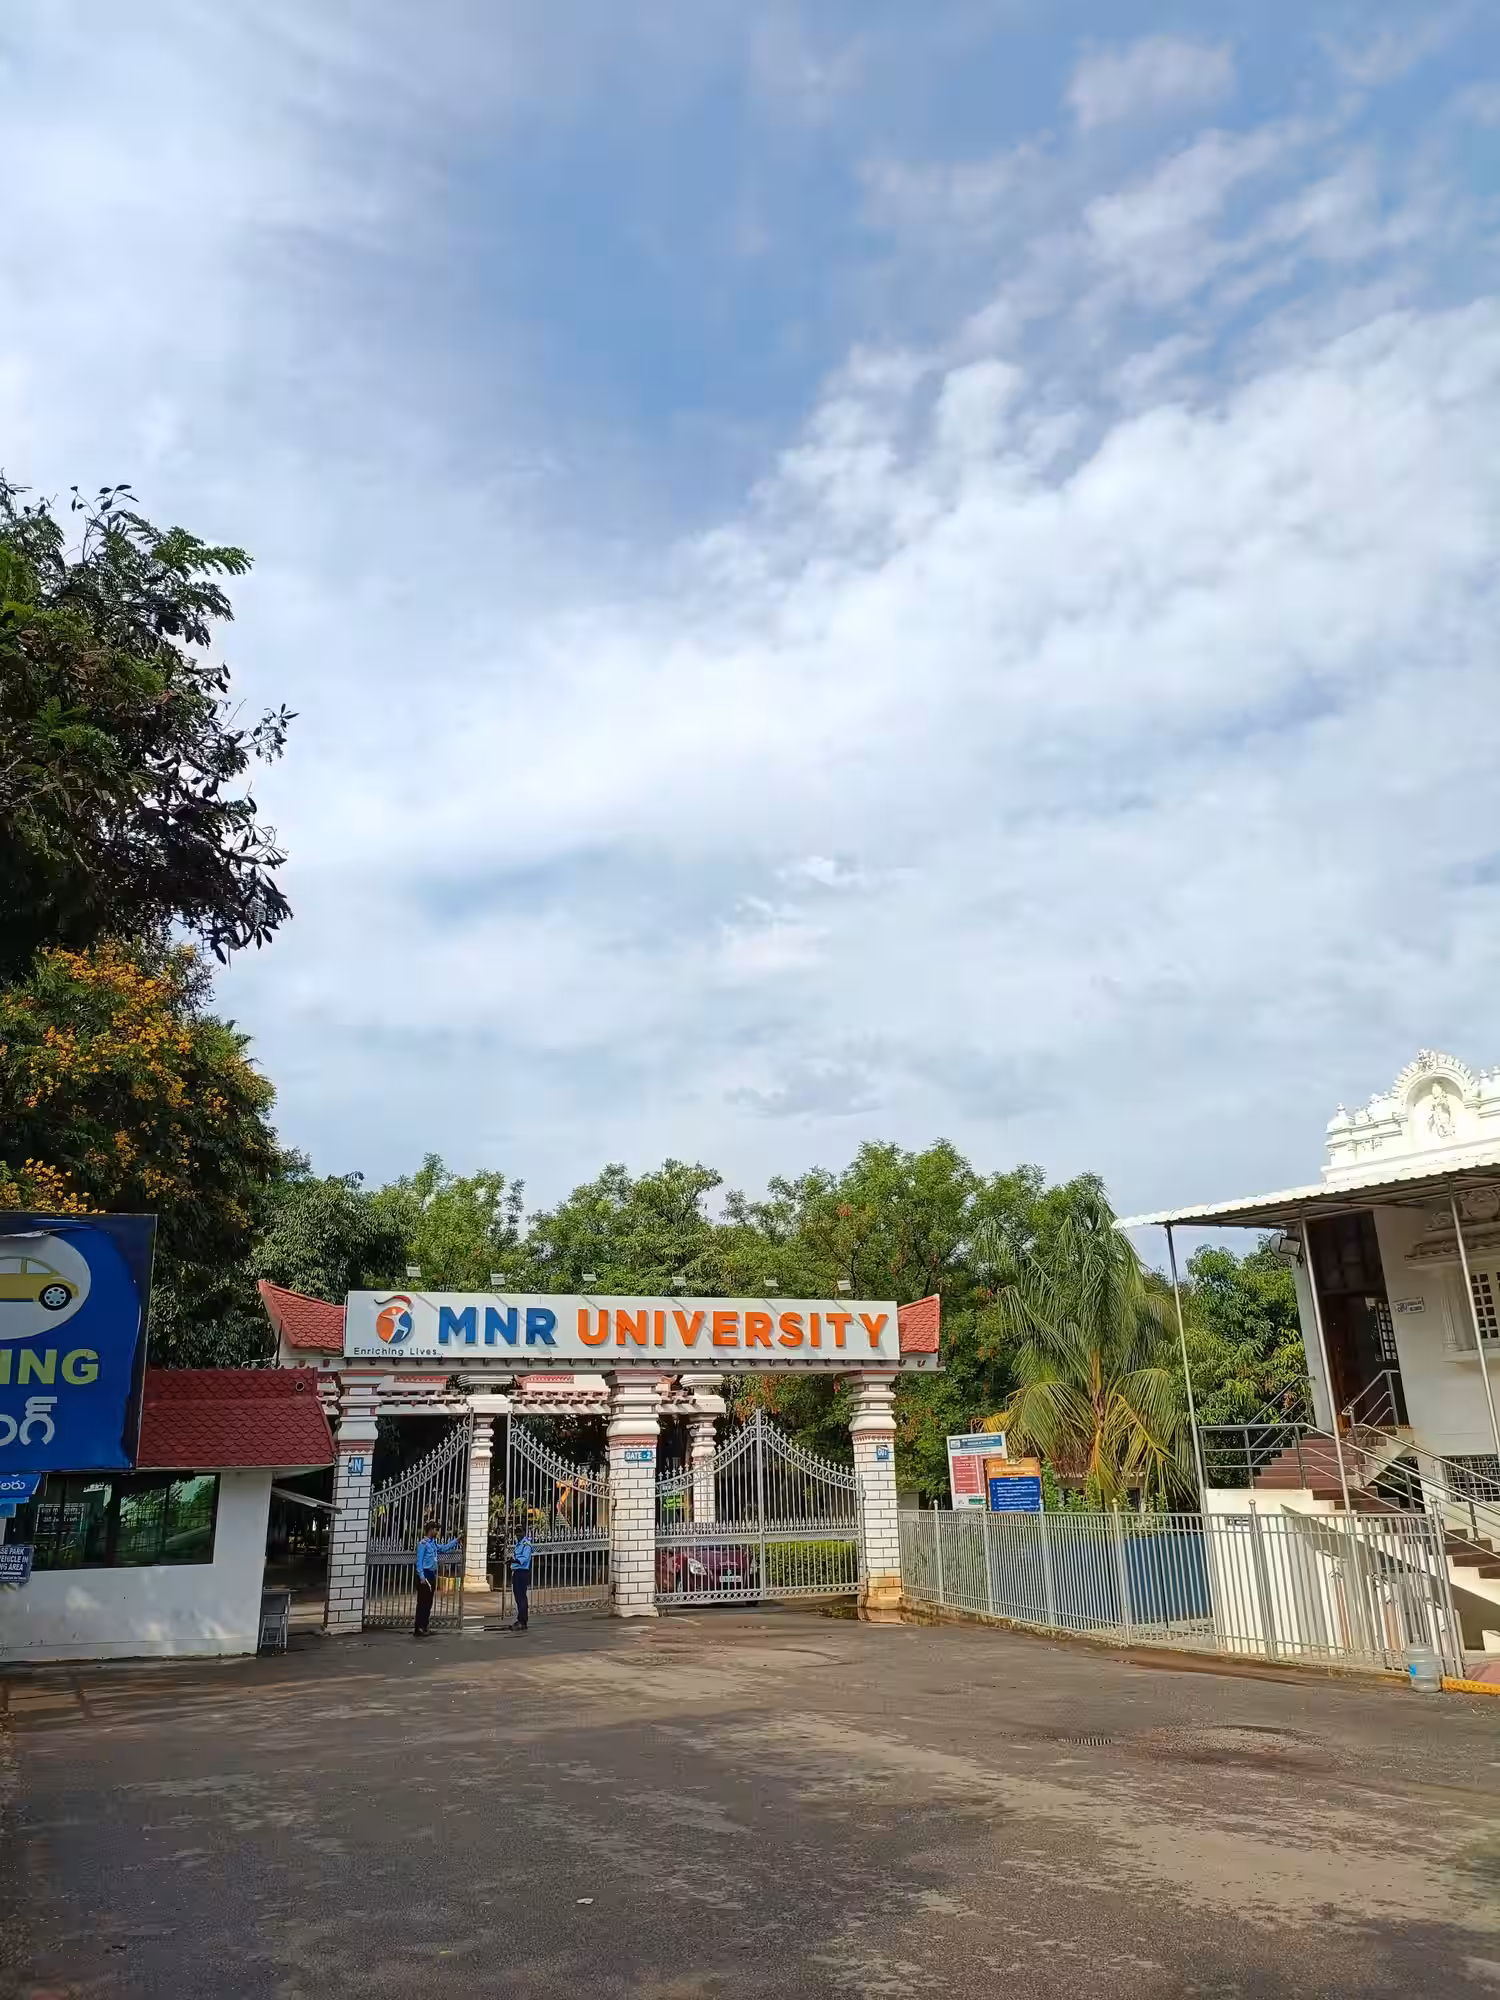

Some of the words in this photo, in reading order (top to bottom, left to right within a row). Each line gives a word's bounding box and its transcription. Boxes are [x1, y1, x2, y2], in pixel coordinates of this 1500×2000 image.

[438, 1306, 557, 1346] MNR
[577, 1308, 888, 1348] UNIVERSITY
[354, 1347, 404, 1356] Enriching
[9, 1547, 25, 1556] PARK
[8, 1563, 24, 1571] AREA
